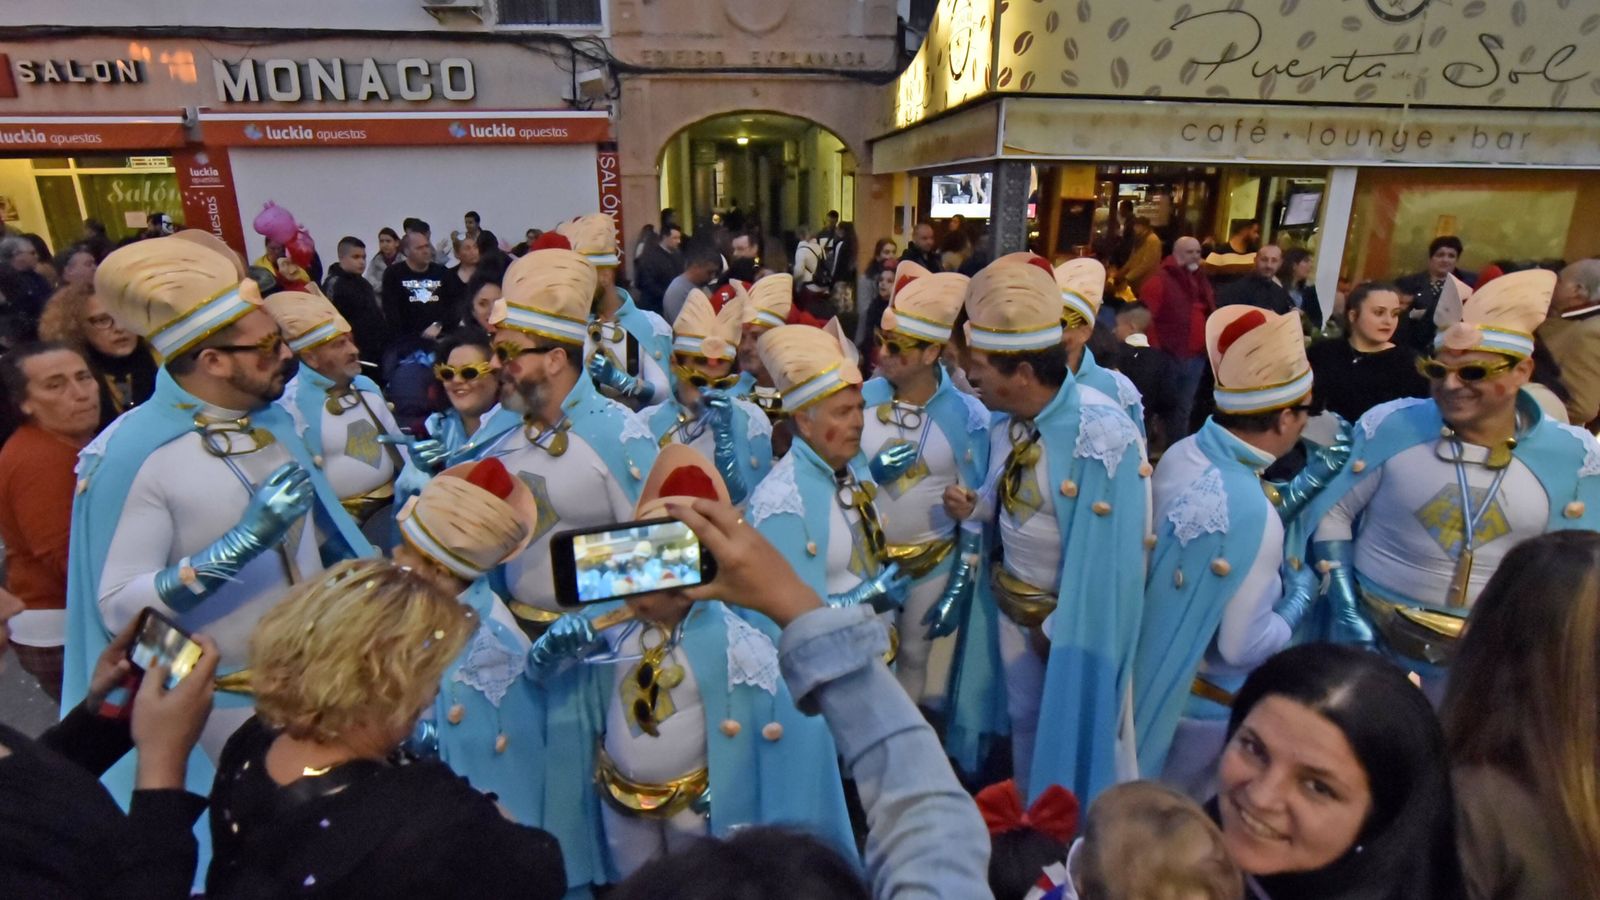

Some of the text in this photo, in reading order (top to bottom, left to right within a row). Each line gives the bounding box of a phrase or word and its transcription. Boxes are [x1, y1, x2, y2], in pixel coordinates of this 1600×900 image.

[1169, 9, 1395, 82] Puerta
[1442, 33, 1591, 88] Sol
[15, 59, 140, 83] SALON
[211, 57, 477, 102] MONACO
[0, 129, 102, 146] luckia apuestas
[265, 125, 367, 141] luckia apuestas
[470, 123, 568, 140] luckia apuestas
[1181, 118, 1531, 153] café lounge bar
[189, 167, 219, 177] luckia
